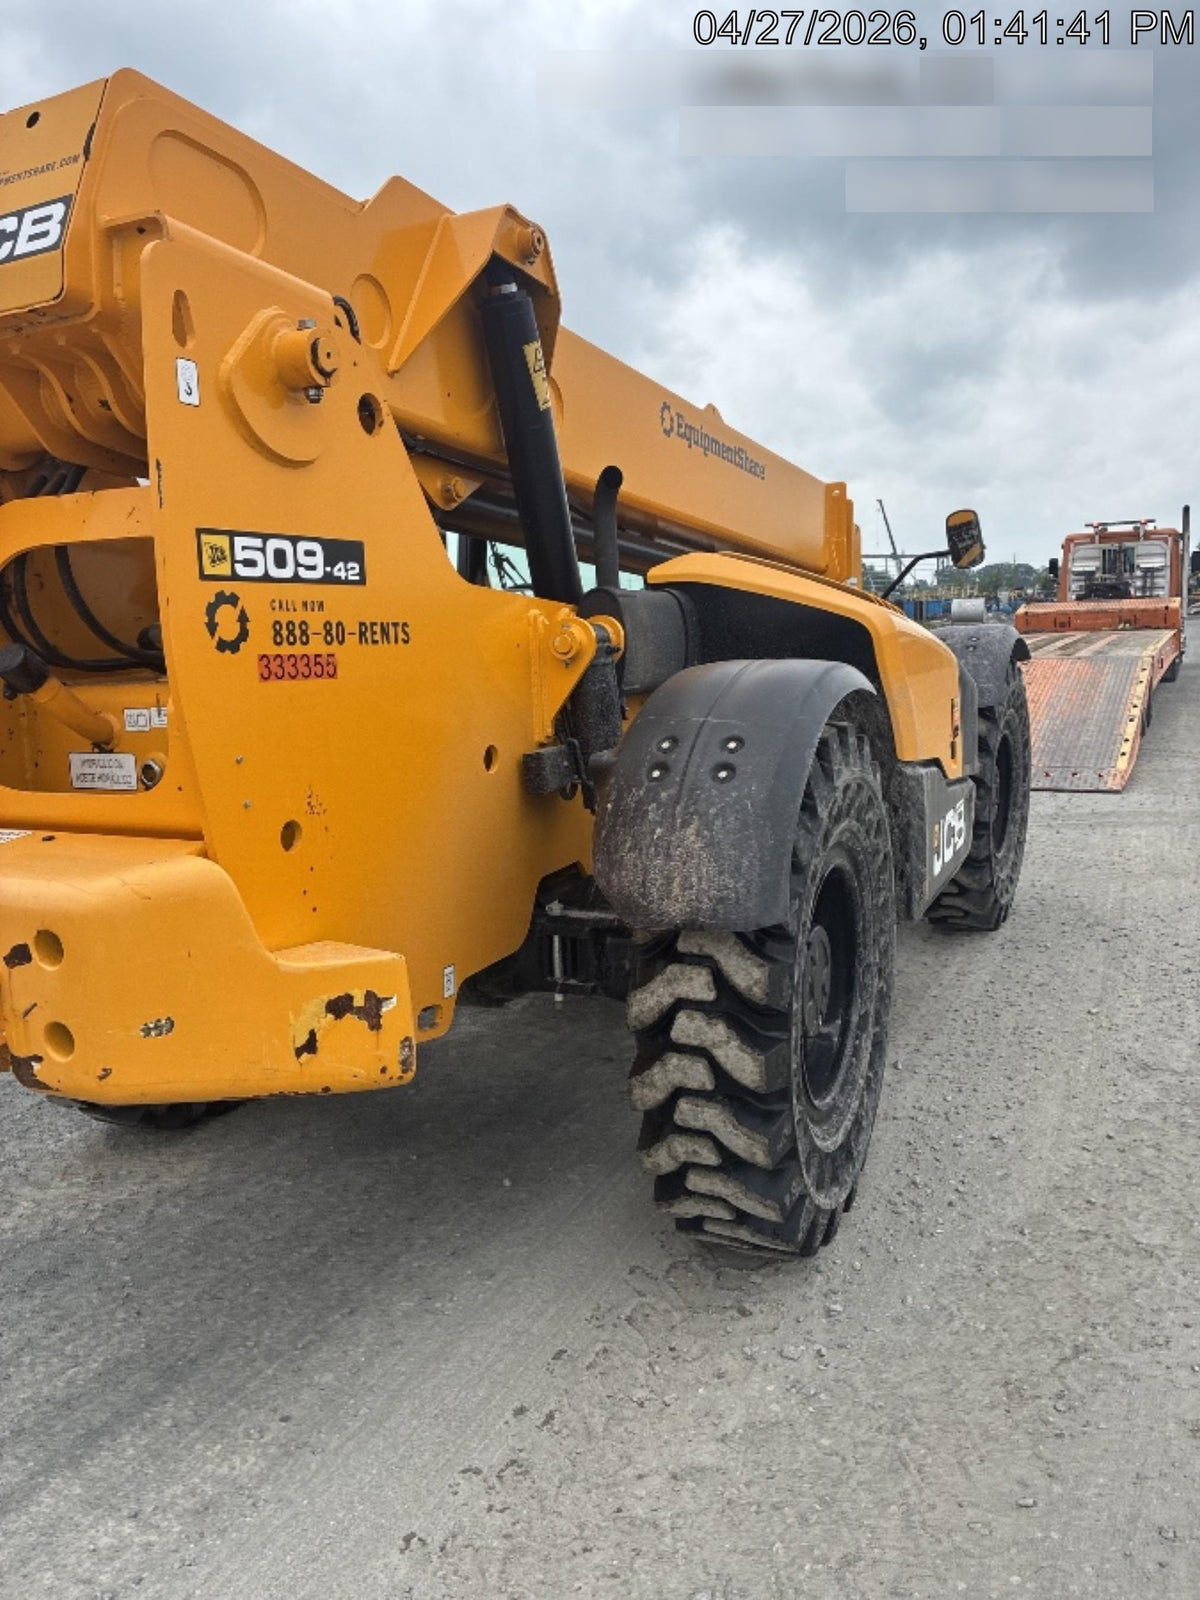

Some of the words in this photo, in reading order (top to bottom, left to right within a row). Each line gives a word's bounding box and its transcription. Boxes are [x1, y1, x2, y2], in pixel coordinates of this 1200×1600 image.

[675, 411, 765, 480] EquipmentShare
[233, 535, 361, 581] 509-42
[269, 598, 298, 612] CALL
[301, 599, 325, 613] NOW
[272, 619, 411, 647] 888-80-RENTS
[259, 653, 337, 681] 333355
[933, 798, 965, 877] JCB
